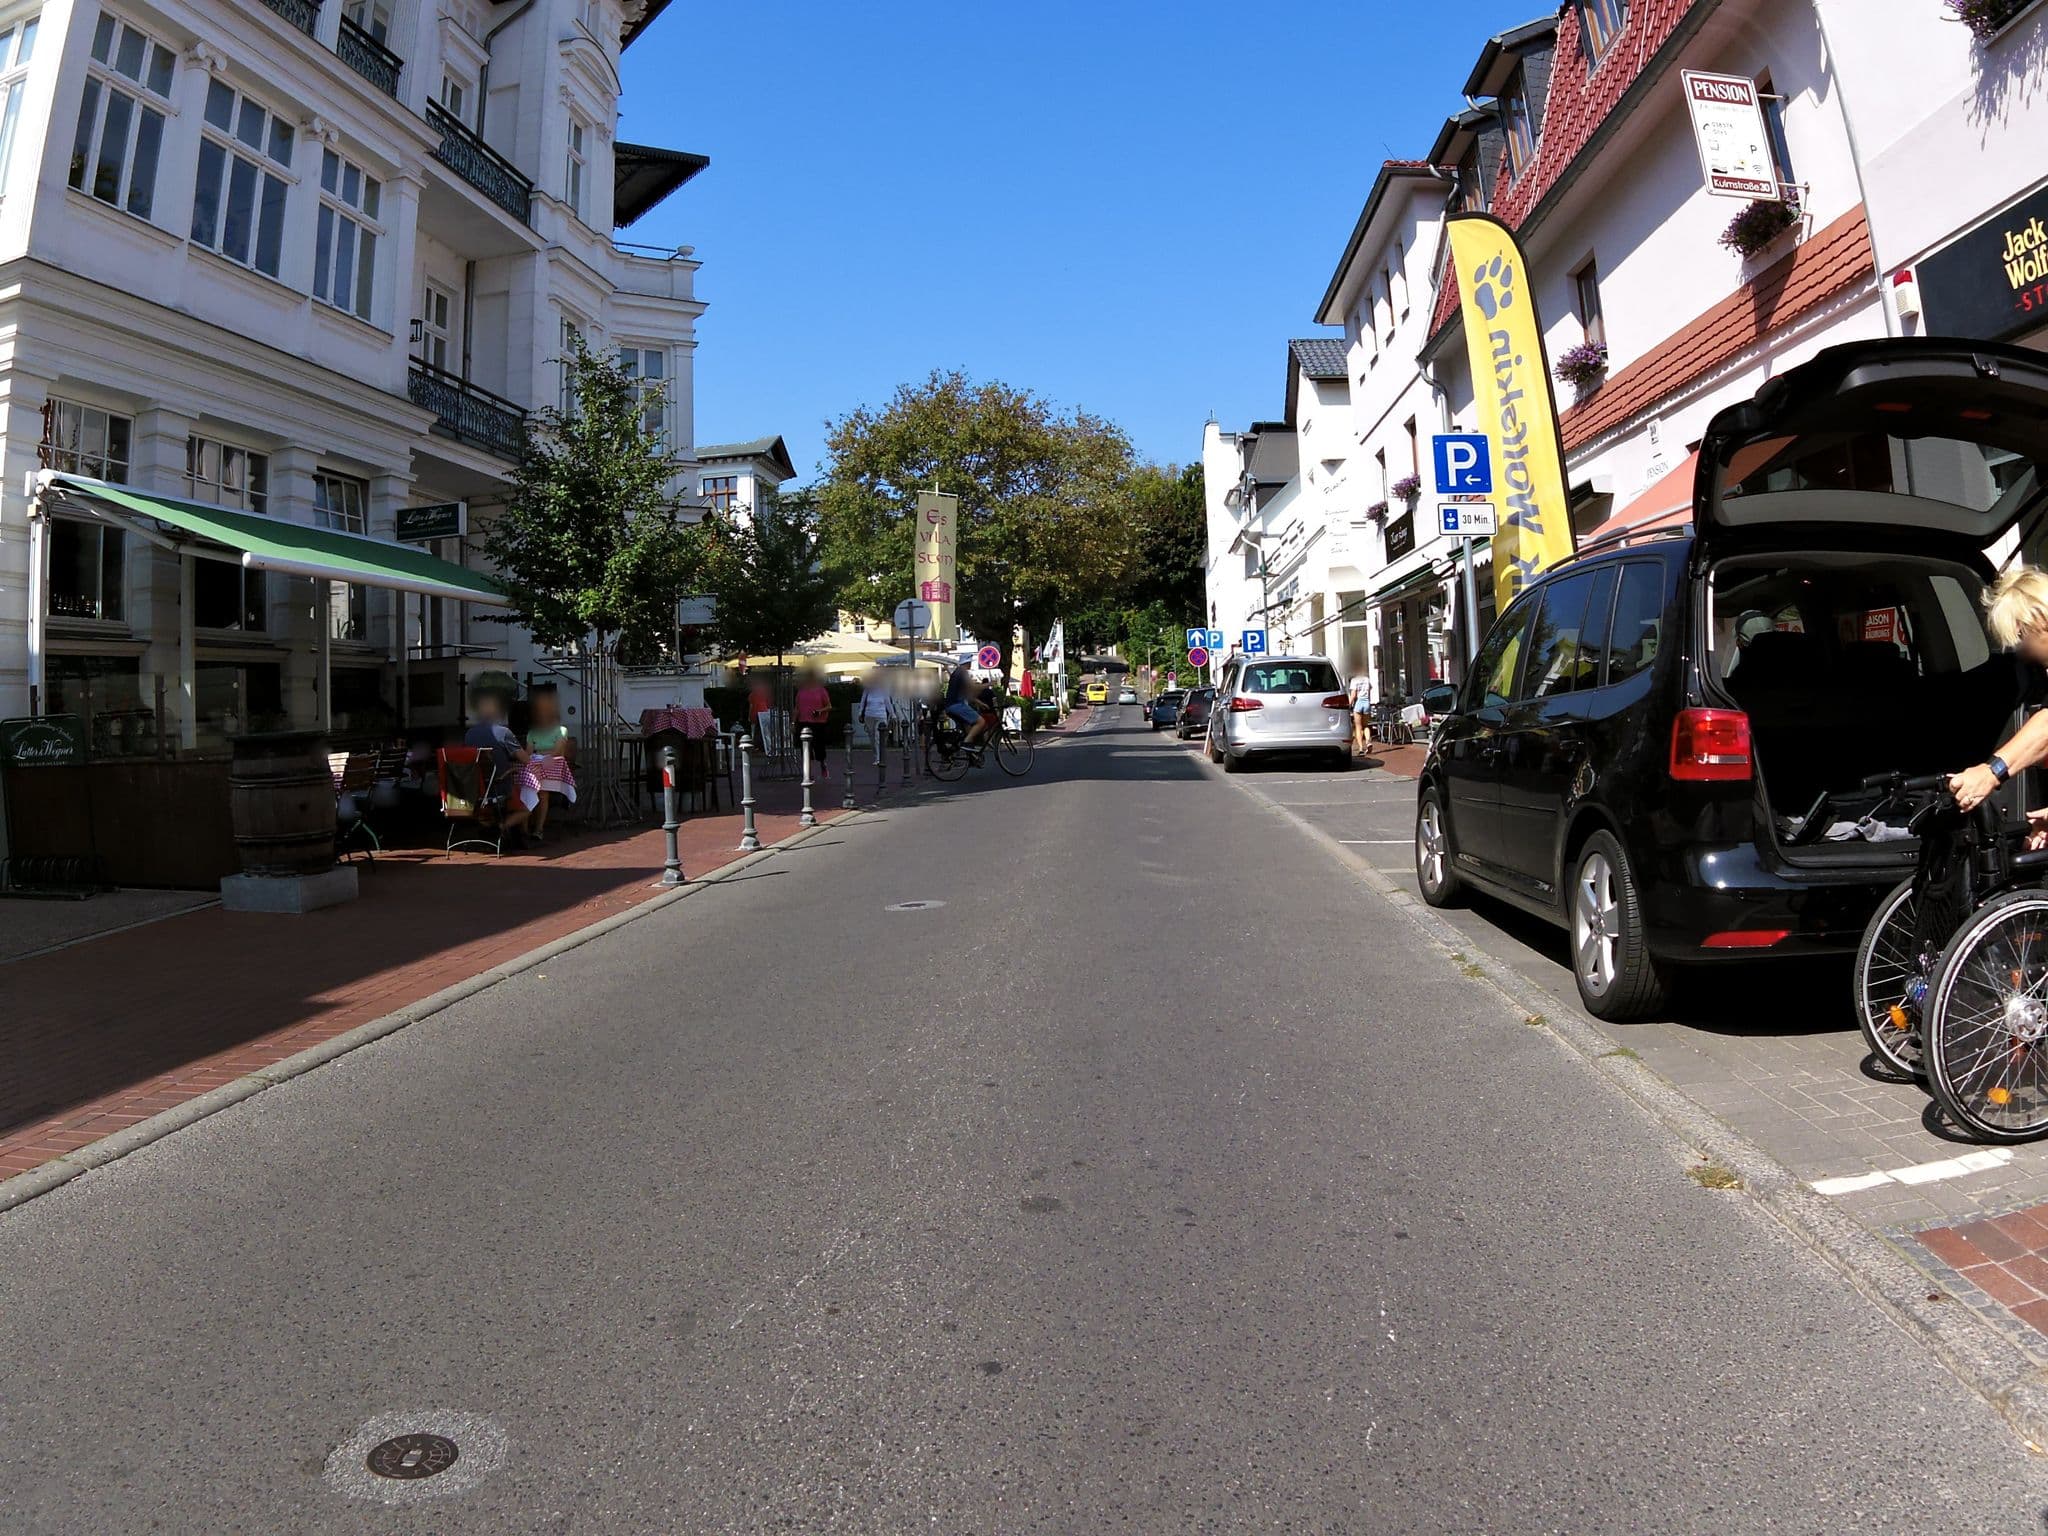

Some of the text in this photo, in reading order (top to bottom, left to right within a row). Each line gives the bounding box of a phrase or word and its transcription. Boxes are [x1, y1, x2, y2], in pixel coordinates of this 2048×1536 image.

[1692, 80, 1750, 103] PENSION
[1759, 182, 1771, 192] 30
[2002, 217, 2048, 262] Jack
[2004, 243, 2048, 290] Wolf
[1445, 441, 1478, 487] P
[1462, 514, 1491, 525] 30 Min.
[1210, 632, 1220, 647] P
[1246, 632, 1260, 650] P
